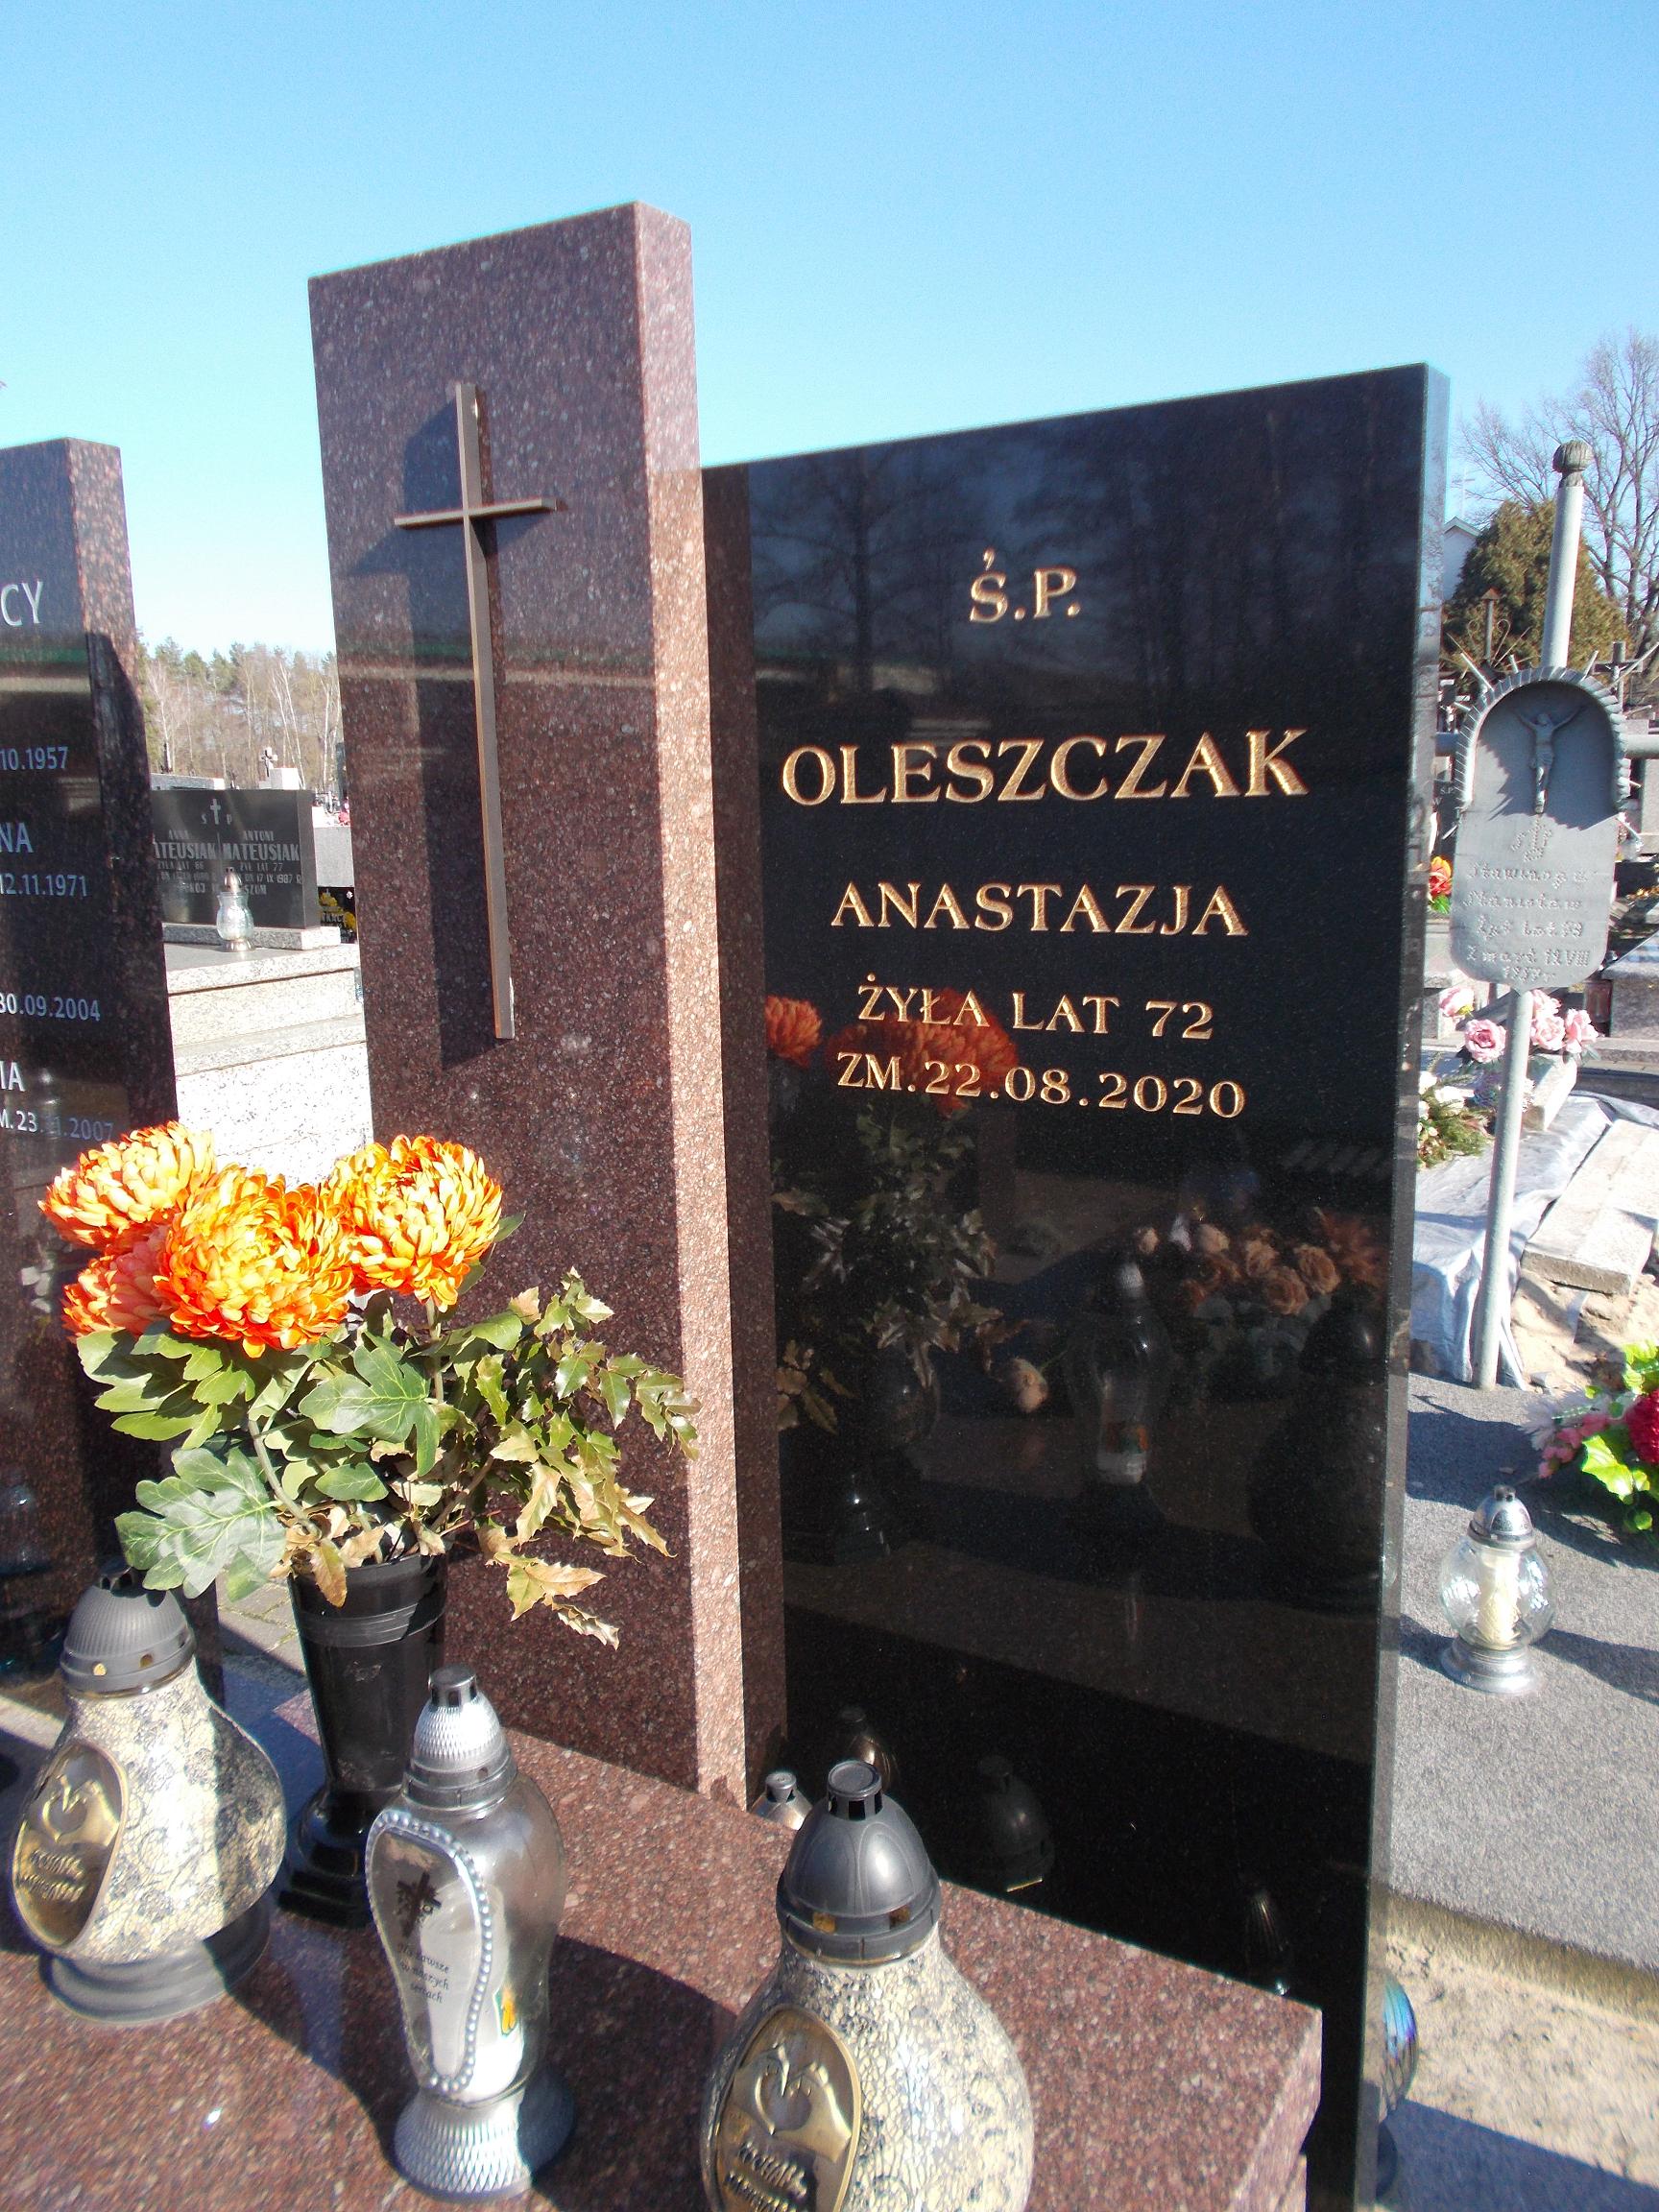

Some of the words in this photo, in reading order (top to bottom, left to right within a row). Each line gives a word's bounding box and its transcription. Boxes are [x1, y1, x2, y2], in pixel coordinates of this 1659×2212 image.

[969, 548, 1081, 623] Ś.P.
[781, 728, 1310, 805] OLESZCZAK
[153, 841, 216, 859] ATEUSIAK
[223, 843, 301, 861] MATEUSIAK
[830, 881, 1249, 937] ANASTAZJA
[856, 973, 991, 1028] ŻYŁA
[1011, 991, 1120, 1035] LAT
[1144, 1000, 1214, 1040] 72
[836, 1051, 1247, 1119] ZM.22.08.2020
